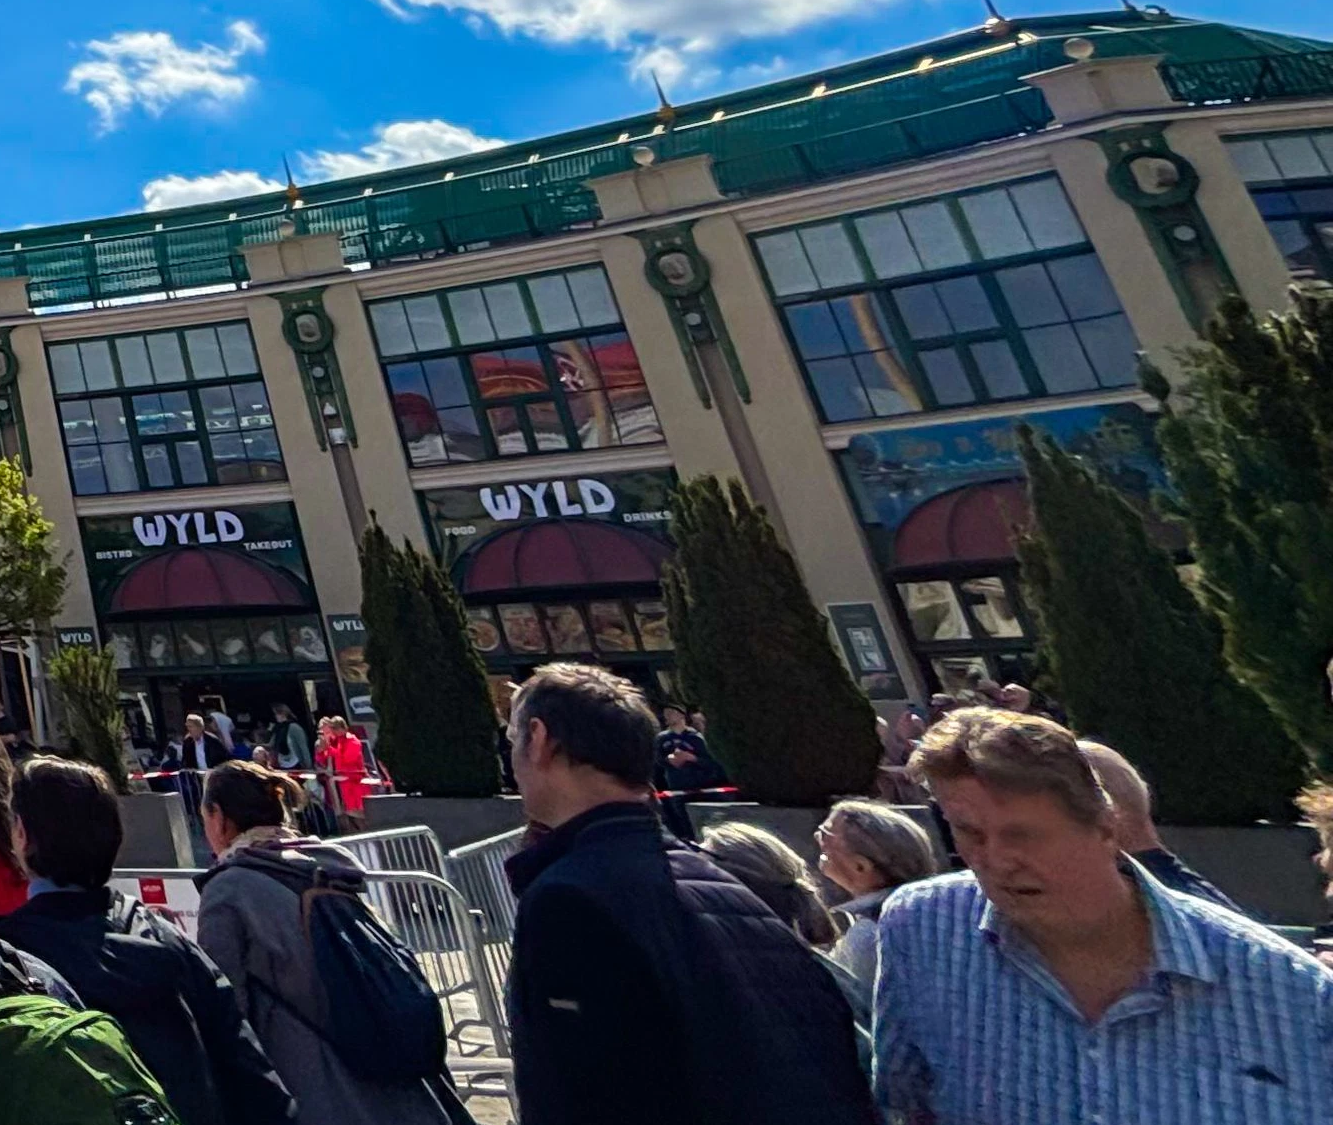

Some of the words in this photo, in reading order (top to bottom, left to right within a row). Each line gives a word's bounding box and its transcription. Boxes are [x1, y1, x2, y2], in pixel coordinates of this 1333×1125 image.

[479, 479, 616, 521] WYLD
[623, 511, 672, 523] DRINKS
[133, 511, 244, 546] WYLD
[444, 526, 477, 536] FOOD
[243, 540, 293, 551] TAKEOUT
[96, 550, 133, 560] BISTRO
[60, 632, 93, 644] WYLD
